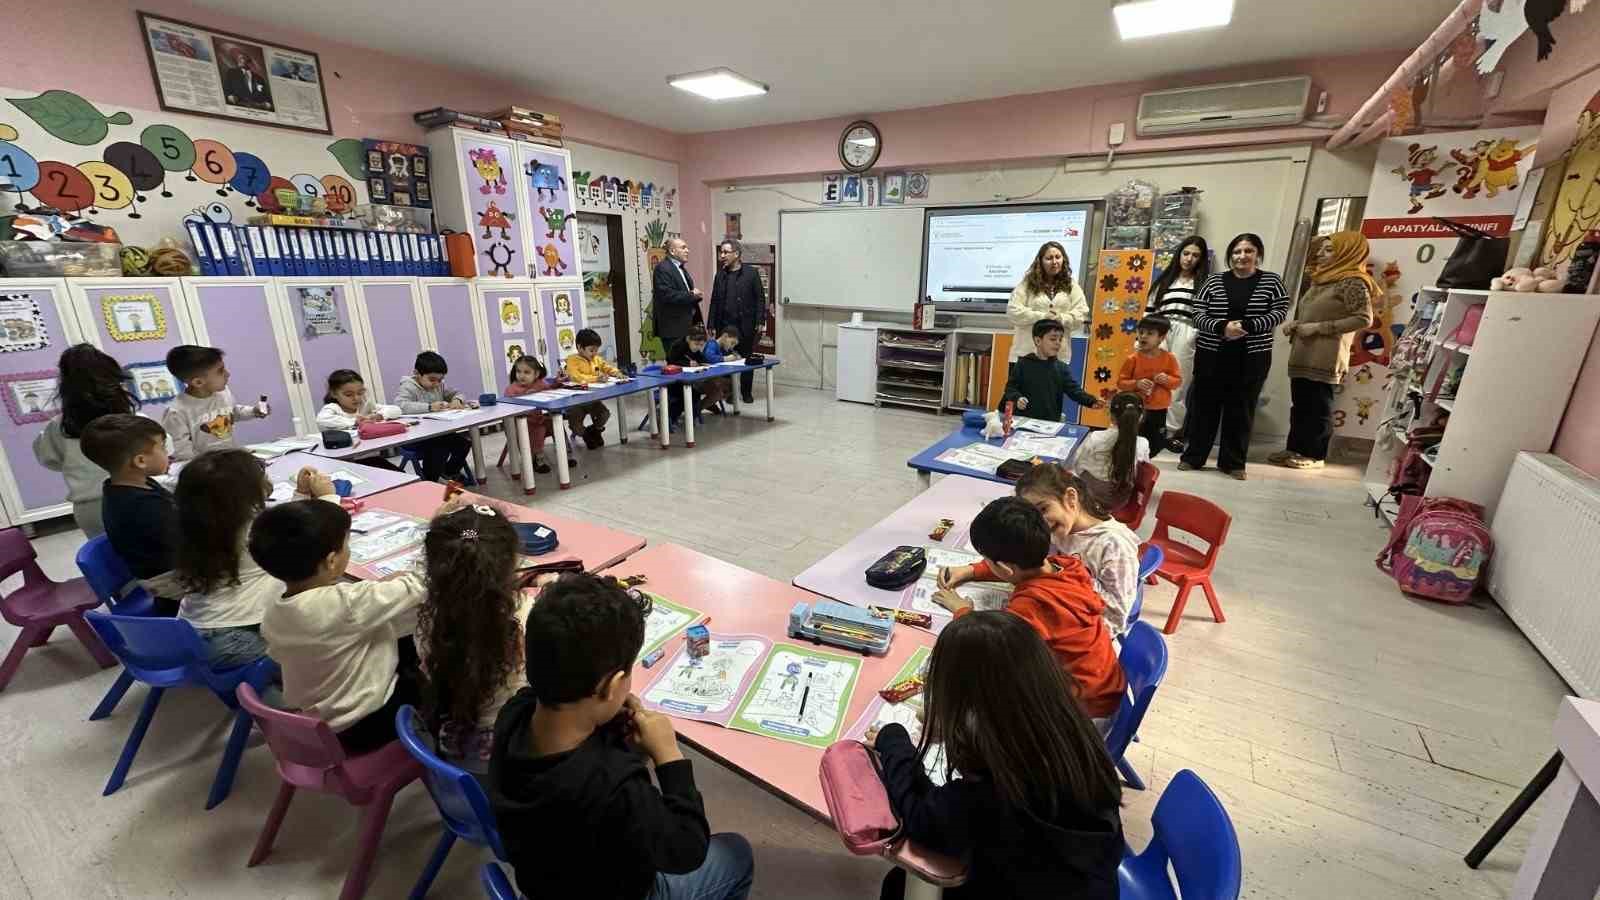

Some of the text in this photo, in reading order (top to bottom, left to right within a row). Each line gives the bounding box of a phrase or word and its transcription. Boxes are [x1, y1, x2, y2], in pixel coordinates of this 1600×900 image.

[161, 136, 181, 160] 5
[1, 154, 22, 177] 1
[204, 150, 223, 175] 6
[48, 170, 79, 198] 2
[94, 174, 120, 201] 3
[240, 166, 257, 188] 7
[330, 184, 352, 204] 10
[1416, 243, 1436, 264] 0
